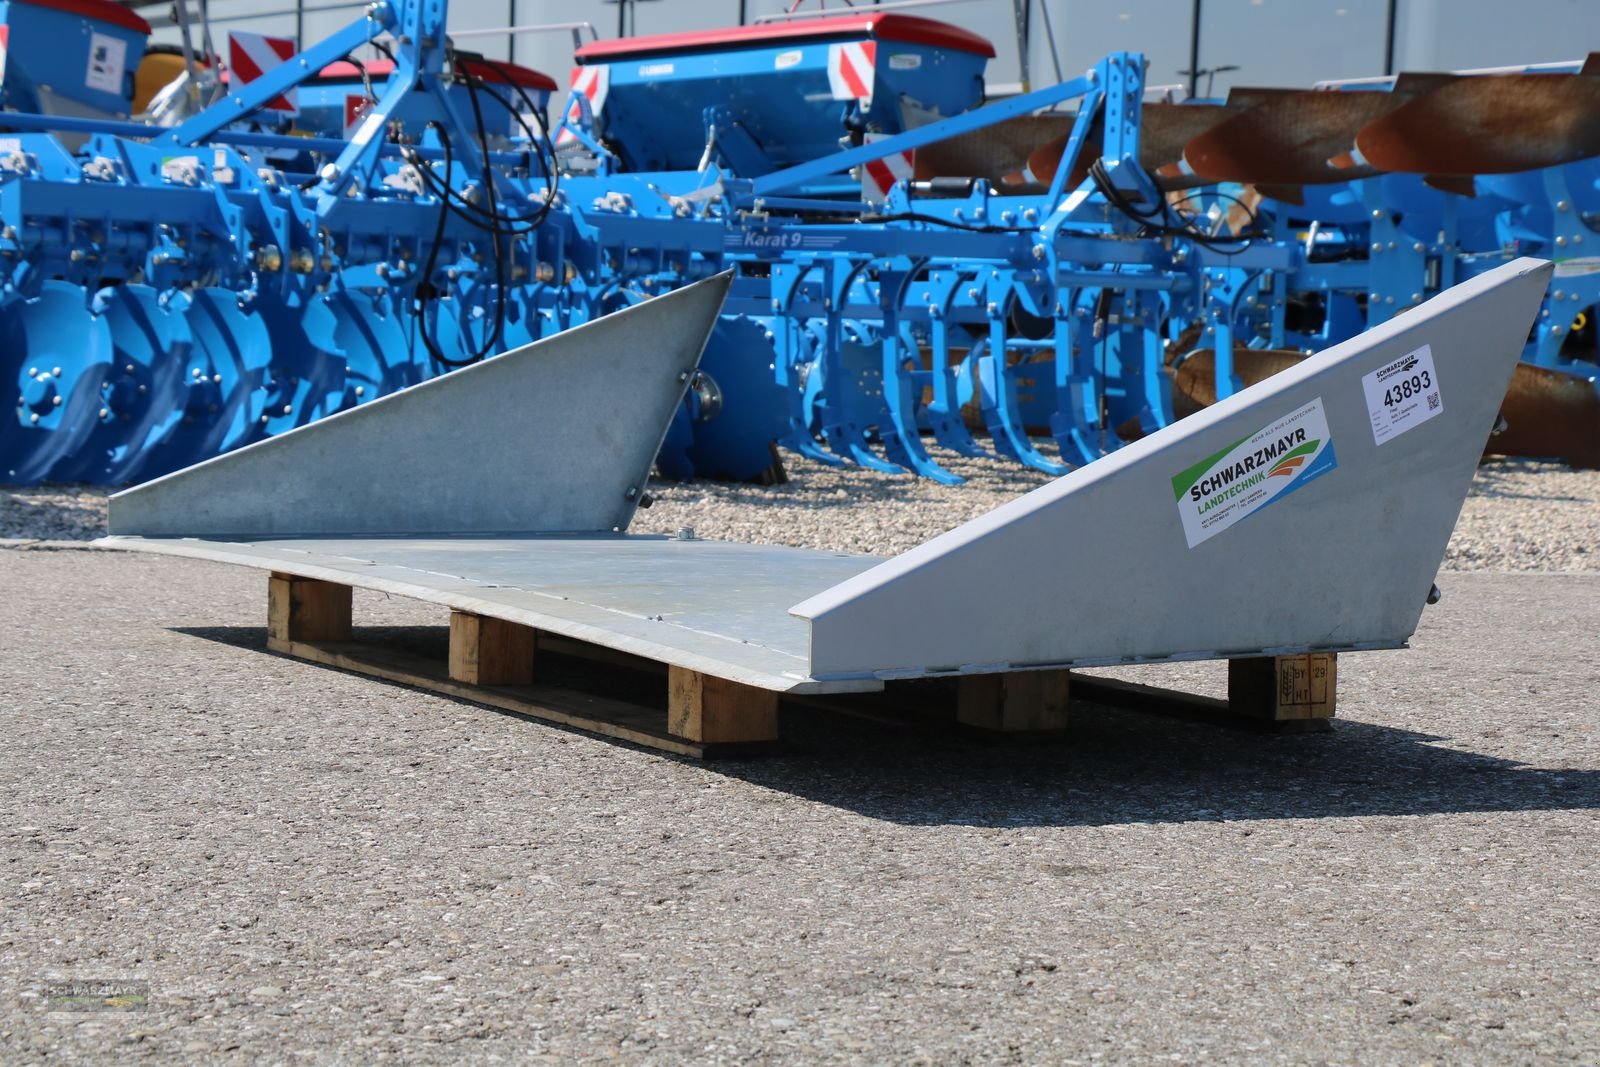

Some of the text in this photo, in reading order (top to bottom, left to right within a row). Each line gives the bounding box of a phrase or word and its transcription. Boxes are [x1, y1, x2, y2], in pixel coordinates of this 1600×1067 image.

[744, 231, 802, 247] Karat 9
[1376, 354, 1415, 379] SCHWARZMAYR
[1384, 370, 1431, 406] 43893
[1190, 427, 1307, 503] SCHWARZMAYR
[1197, 470, 1267, 515] LANDTECHNIK
